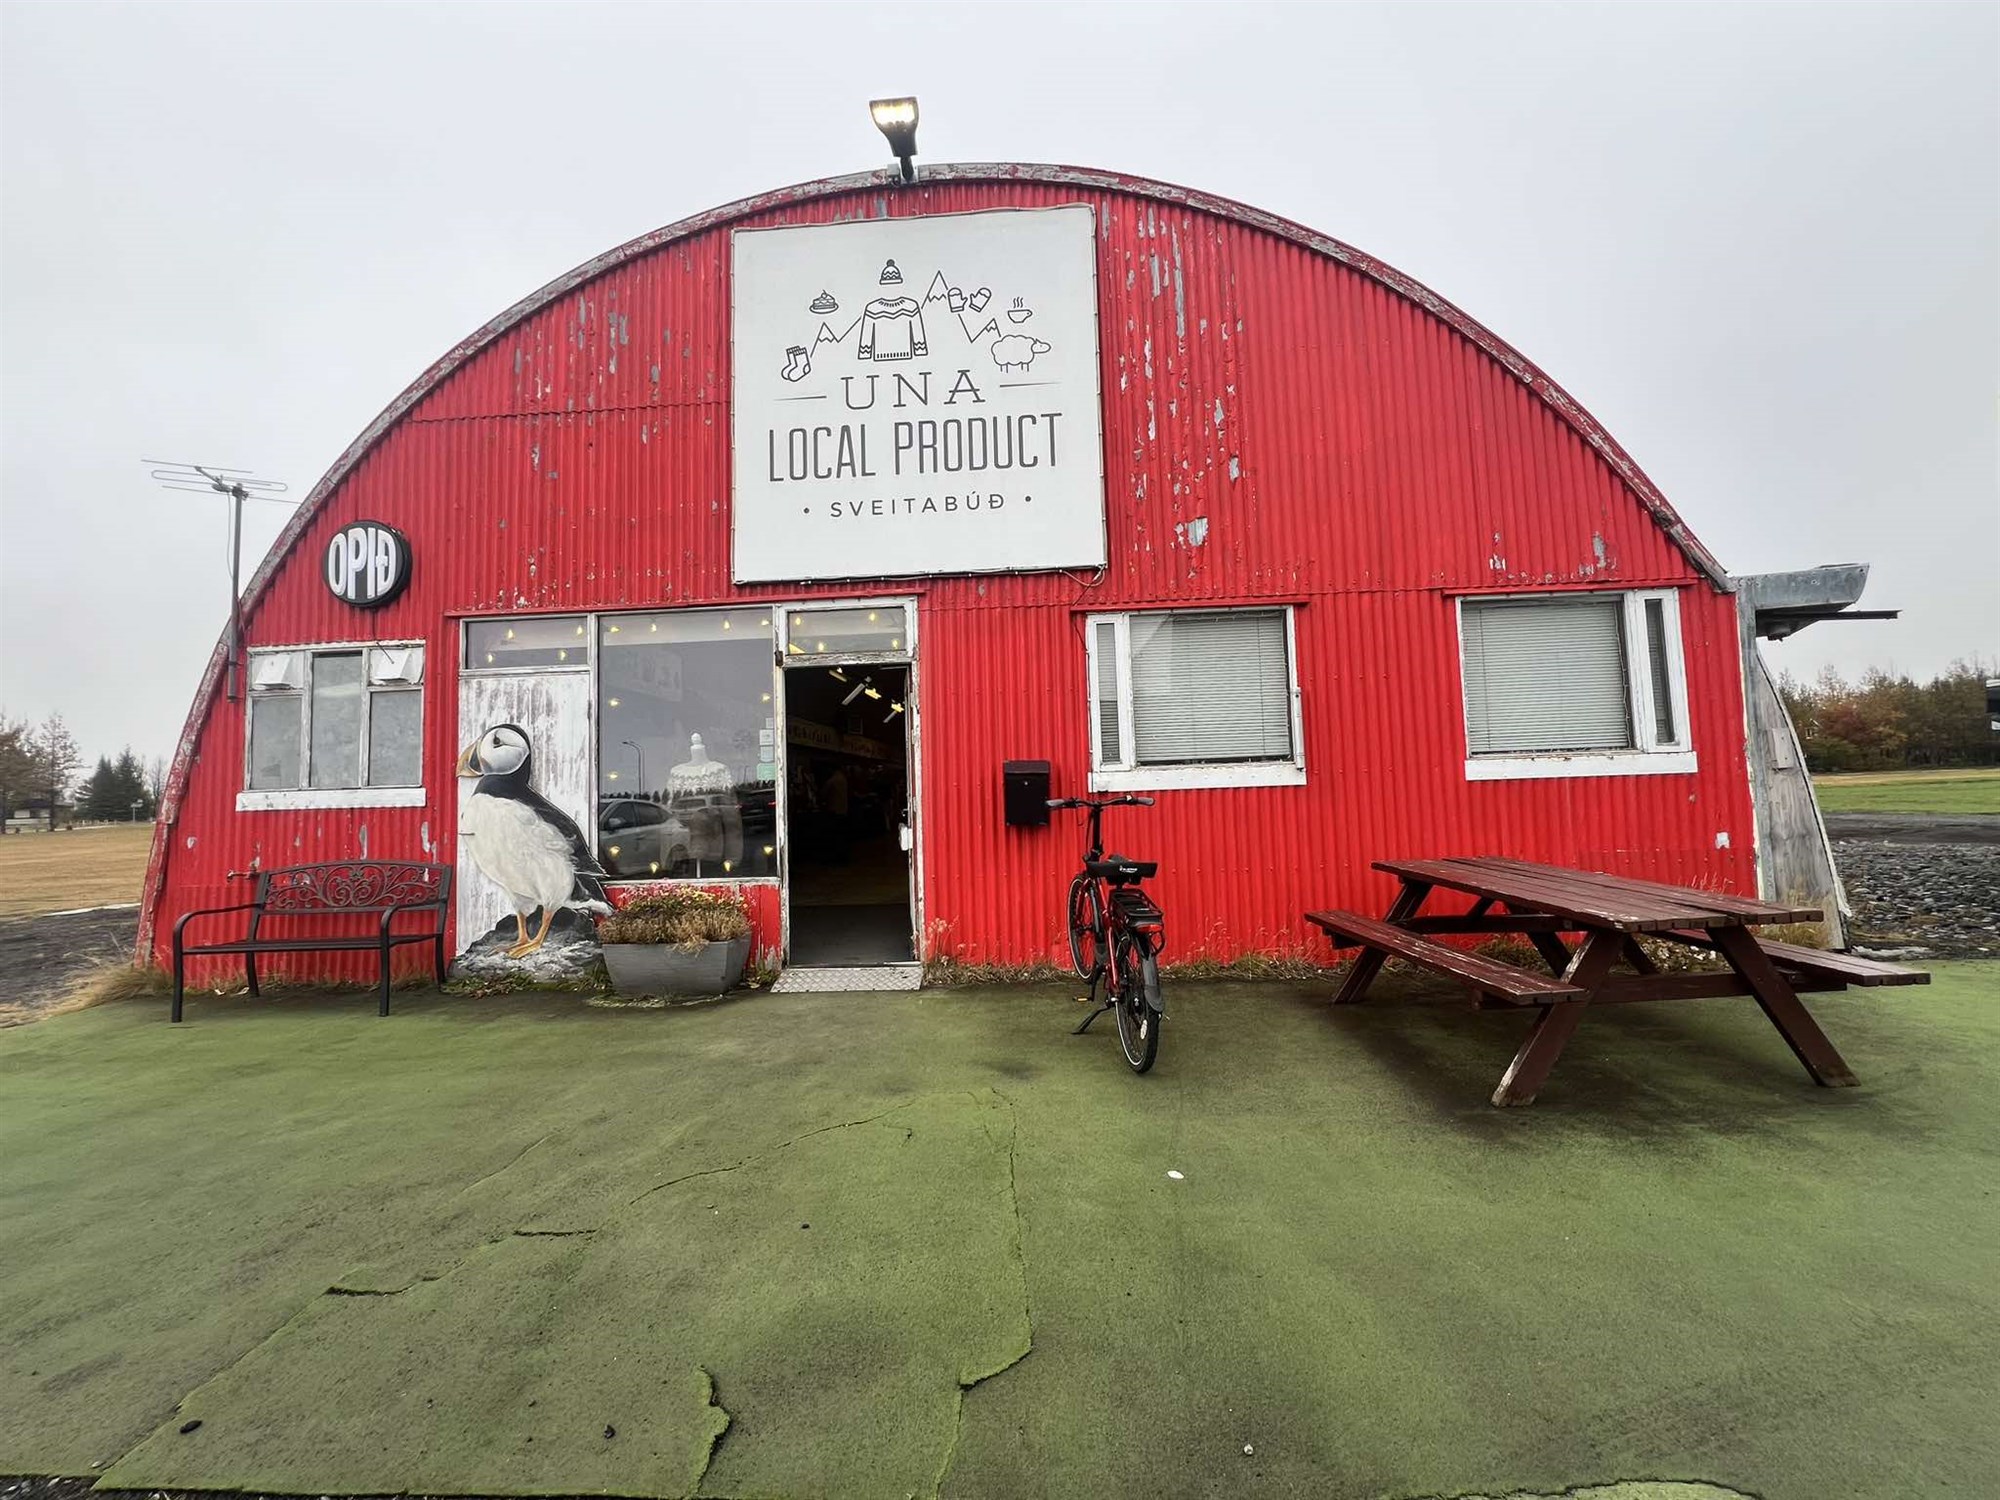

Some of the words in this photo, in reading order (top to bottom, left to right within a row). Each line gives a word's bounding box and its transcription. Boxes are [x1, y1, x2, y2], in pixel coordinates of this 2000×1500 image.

[840, 369, 986, 410] UNA
[768, 423, 877, 482] LOCAL
[894, 412, 1063, 475] PRODUCT
[830, 490, 1005, 518] SVEITABÚÐ
[328, 527, 397, 600] OPIÐ
